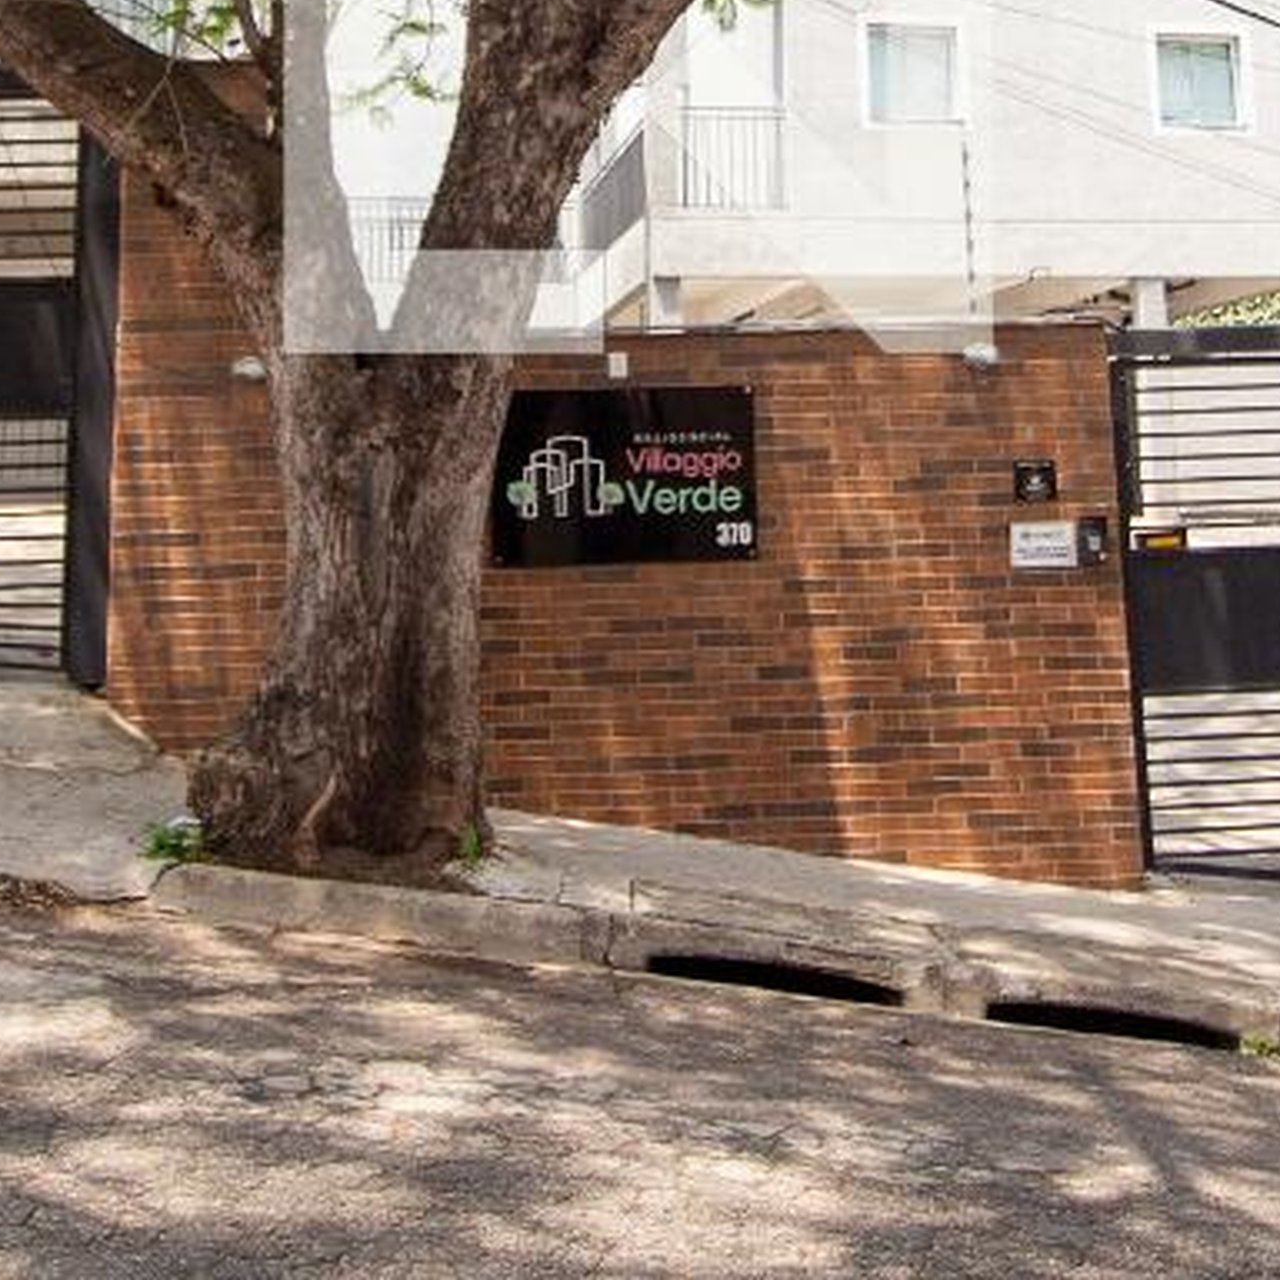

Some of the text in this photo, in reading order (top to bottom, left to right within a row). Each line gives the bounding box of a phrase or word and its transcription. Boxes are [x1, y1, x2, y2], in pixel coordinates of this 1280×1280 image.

[625, 445, 741, 477] Villaggio
[625, 479, 742, 514] Verde
[716, 522, 752, 546] 370
